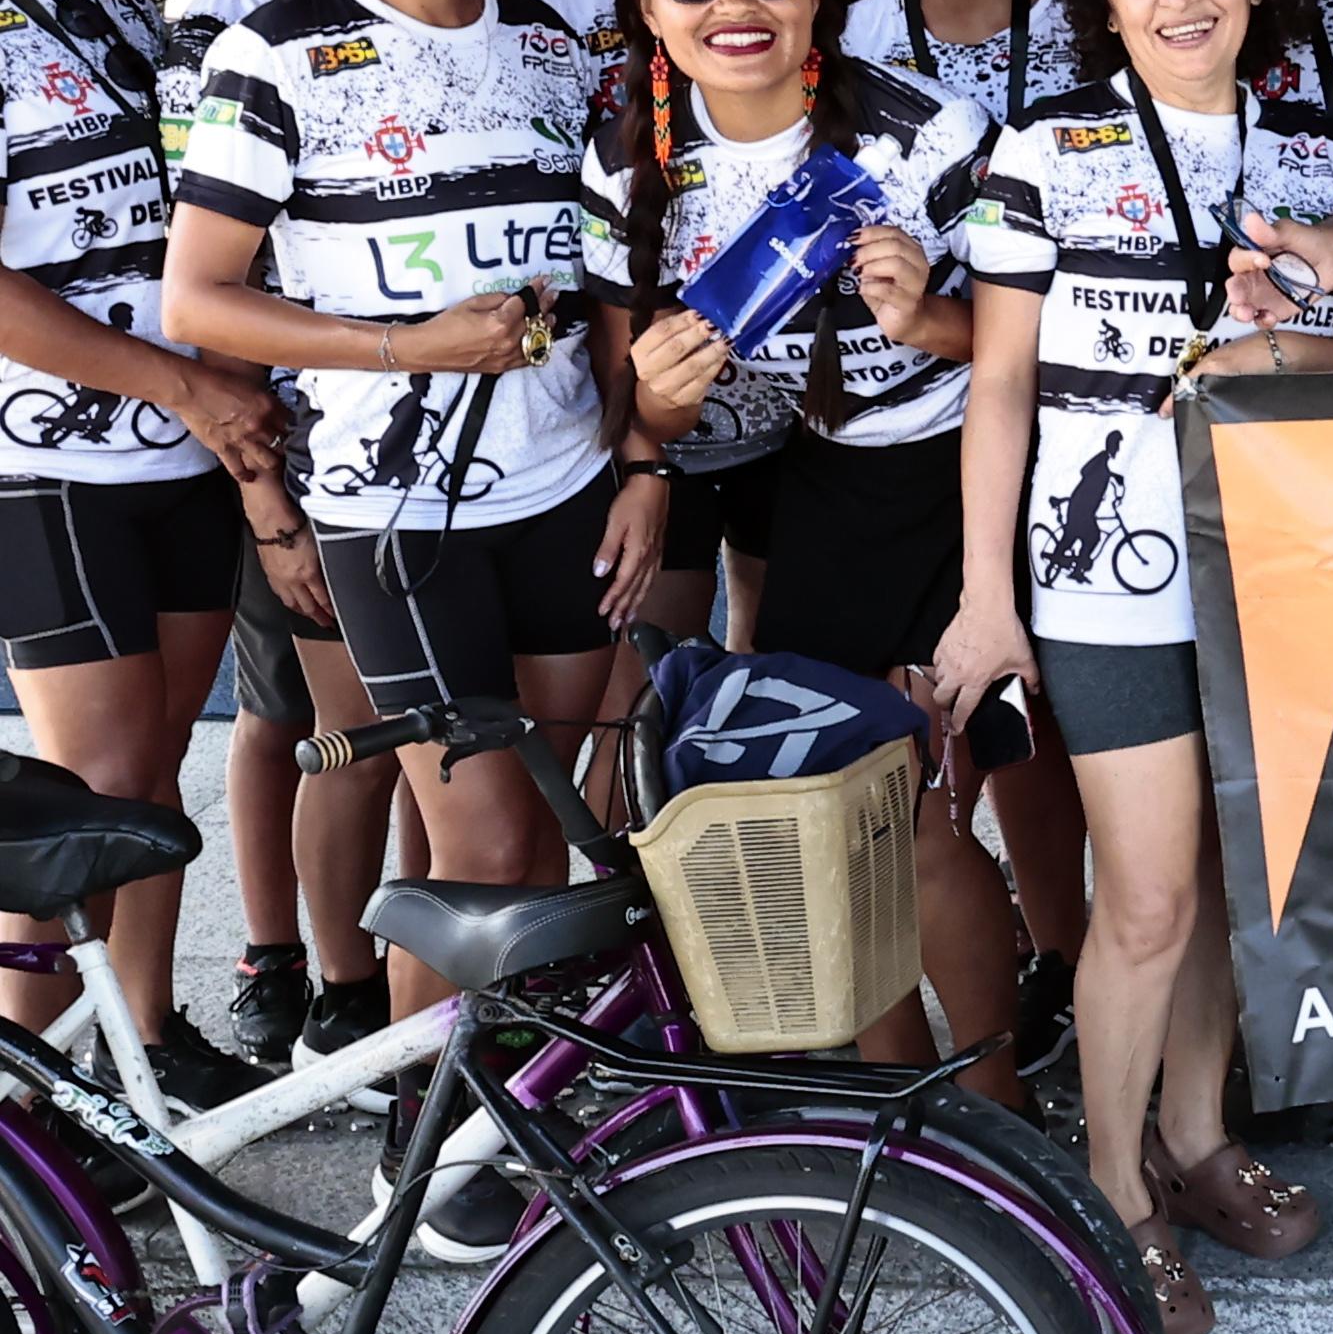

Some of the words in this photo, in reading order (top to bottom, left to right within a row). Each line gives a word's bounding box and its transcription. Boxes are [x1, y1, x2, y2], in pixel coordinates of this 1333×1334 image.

[66, 114, 111, 139] HBP
[28, 156, 159, 210] FESTIVAL
[377, 176, 430, 200] HBP
[130, 201, 162, 227] DE
[1117, 235, 1161, 253] HBP
